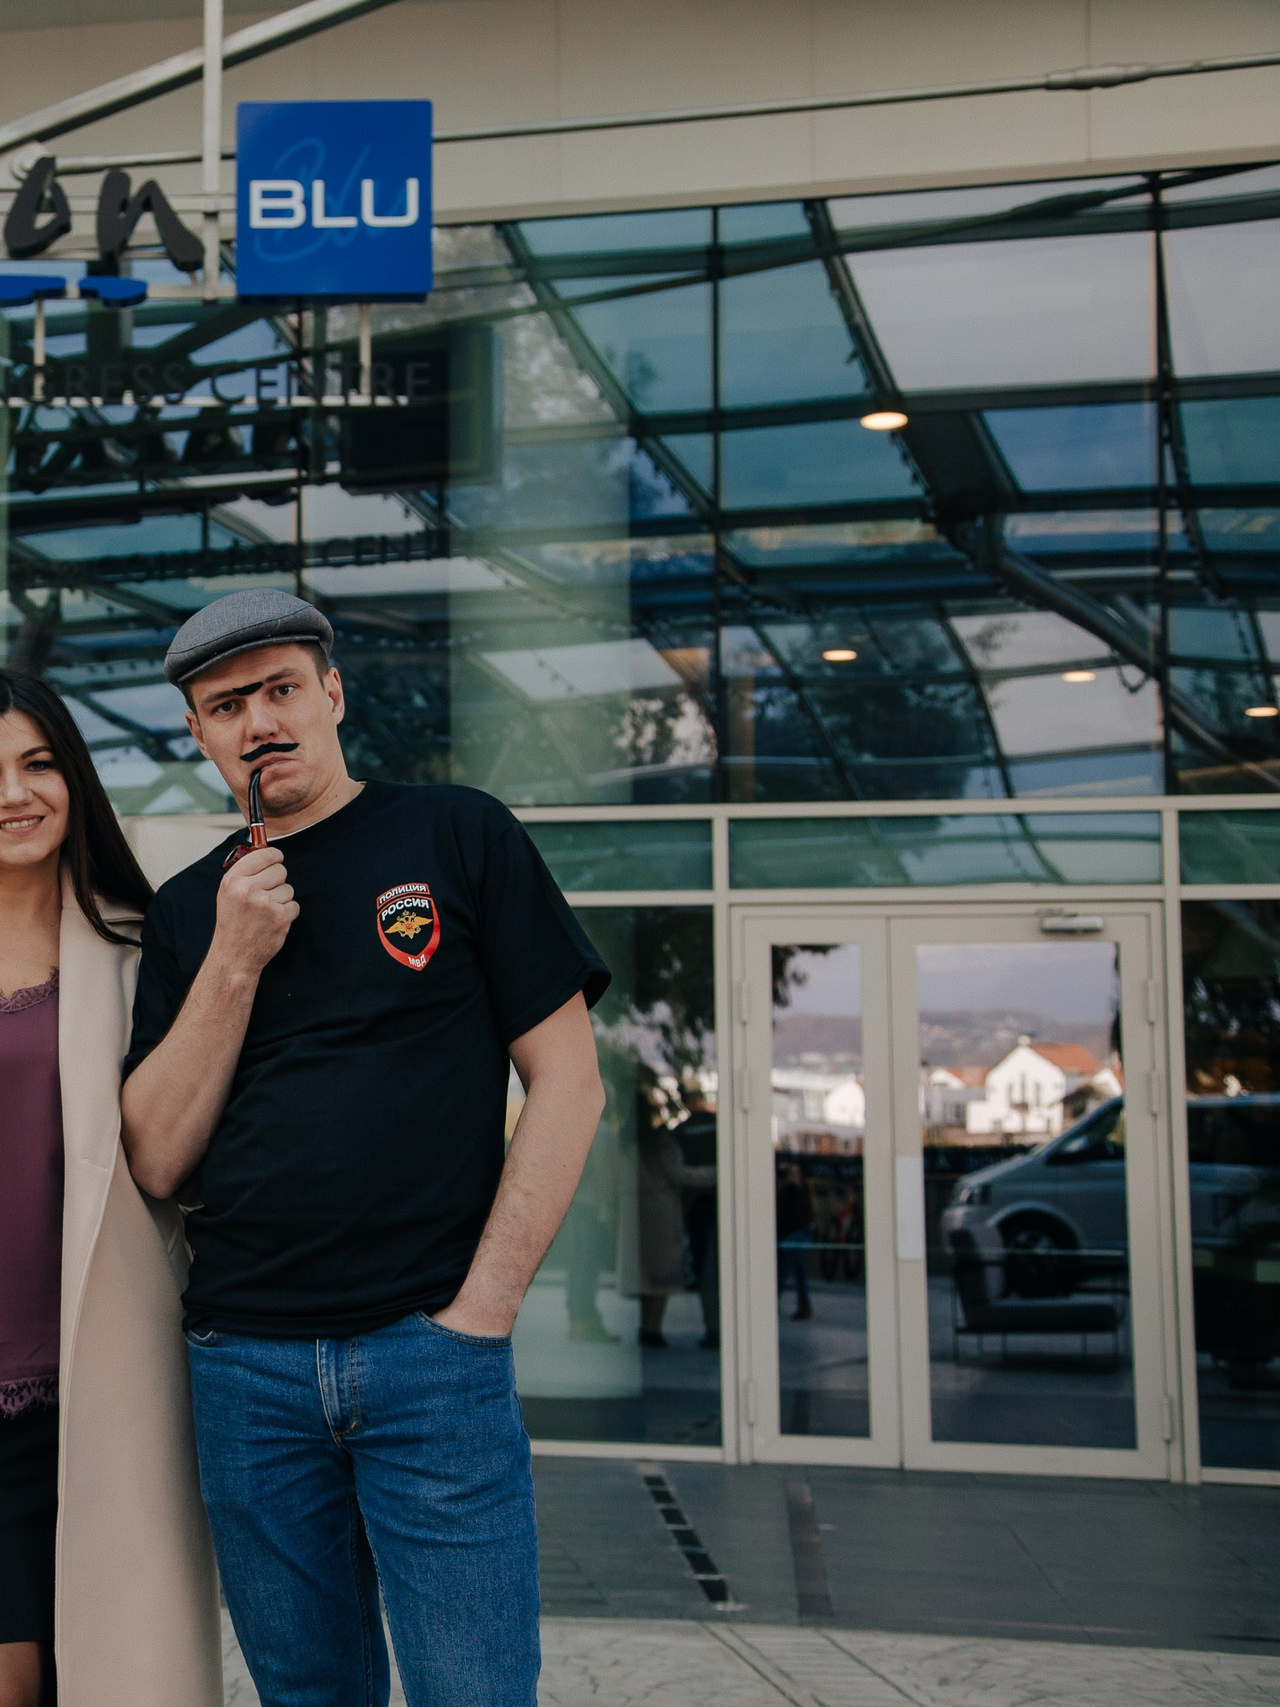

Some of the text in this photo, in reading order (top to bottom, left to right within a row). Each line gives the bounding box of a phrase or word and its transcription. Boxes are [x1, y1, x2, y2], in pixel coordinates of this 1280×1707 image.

[249, 177, 419, 229] BLU
[209, 360, 433, 403] CENTRE
[379, 884, 427, 904] ПОЛИЦИЯ
[381, 898, 430, 921] РОССИЯ
